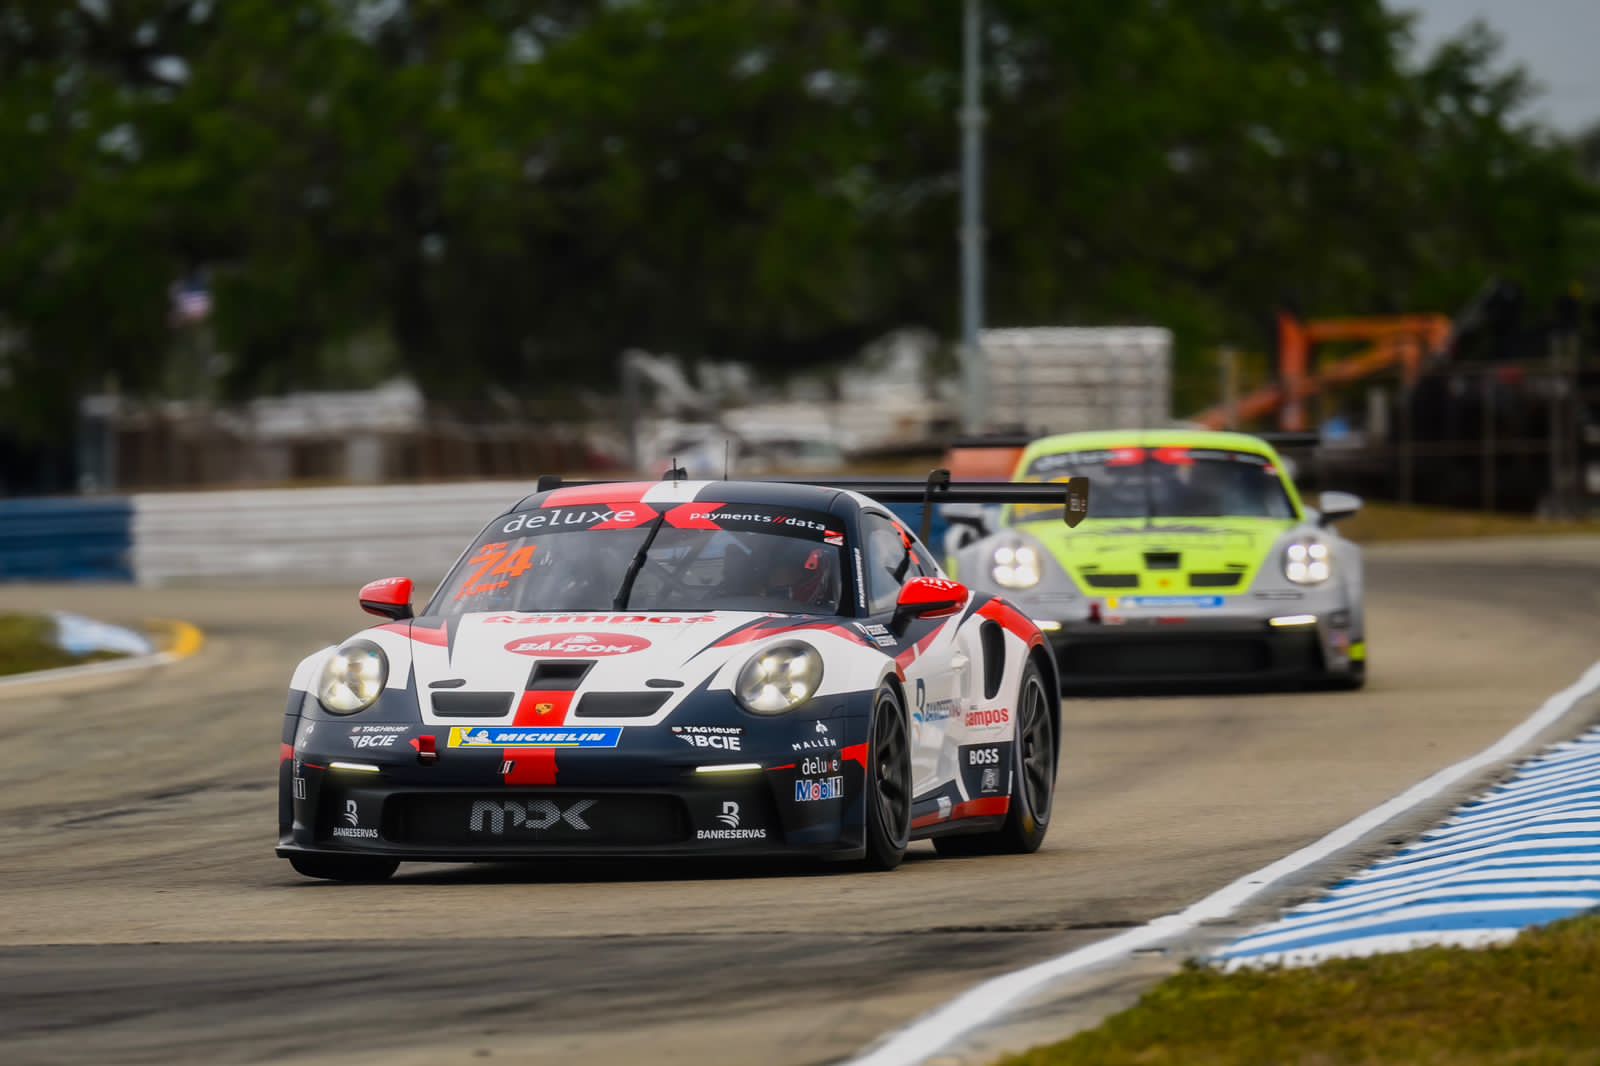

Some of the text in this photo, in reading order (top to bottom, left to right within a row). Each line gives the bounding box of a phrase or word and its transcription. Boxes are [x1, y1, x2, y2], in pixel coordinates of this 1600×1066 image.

[503, 509, 635, 534] deluxe
[689, 511, 826, 531] payments//data
[511, 643, 634, 653] BALDOM
[965, 708, 1009, 727] campos
[357, 735, 398, 748] BCIE
[495, 732, 607, 742] MICHELIN
[694, 735, 741, 751] BCIE
[969, 748, 999, 765] BOSS
[333, 826, 379, 838] BANRESERVAS
[697, 828, 767, 840] BANRESERVAS
